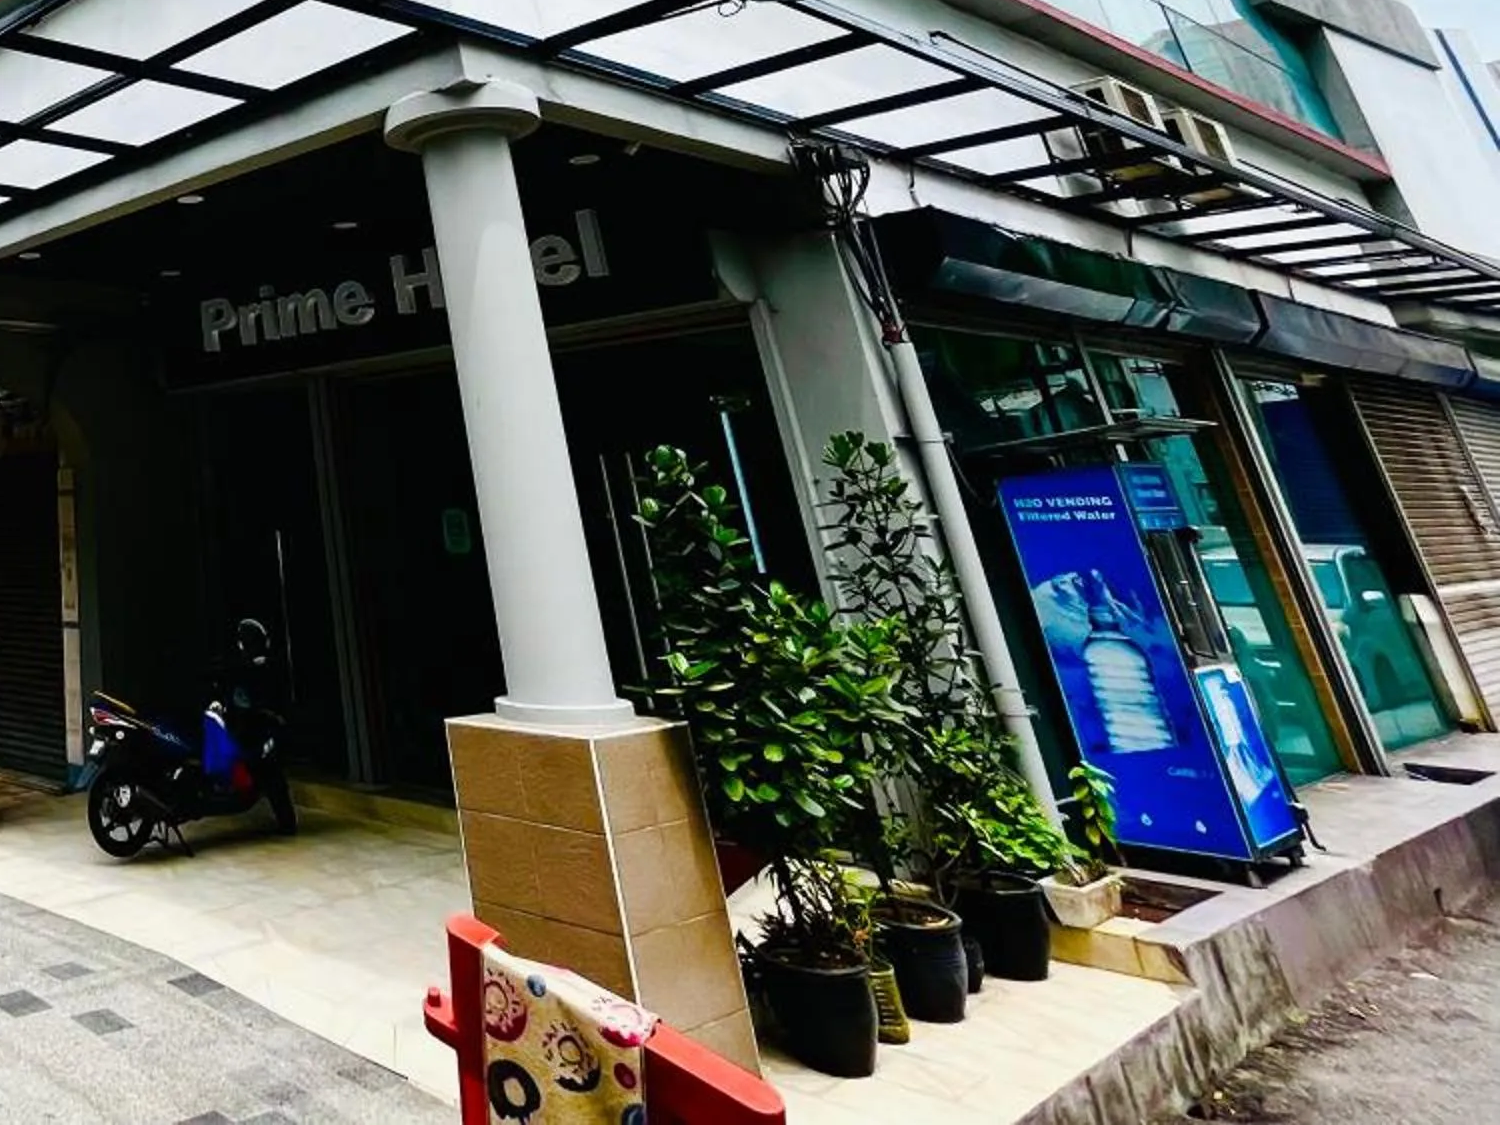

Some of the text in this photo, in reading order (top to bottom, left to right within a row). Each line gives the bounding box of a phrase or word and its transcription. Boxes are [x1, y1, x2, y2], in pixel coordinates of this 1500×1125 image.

[200, 209, 610, 353] Prime Hel
[1046, 496, 1113, 507] VENDING
[1073, 510, 1116, 521] Water
